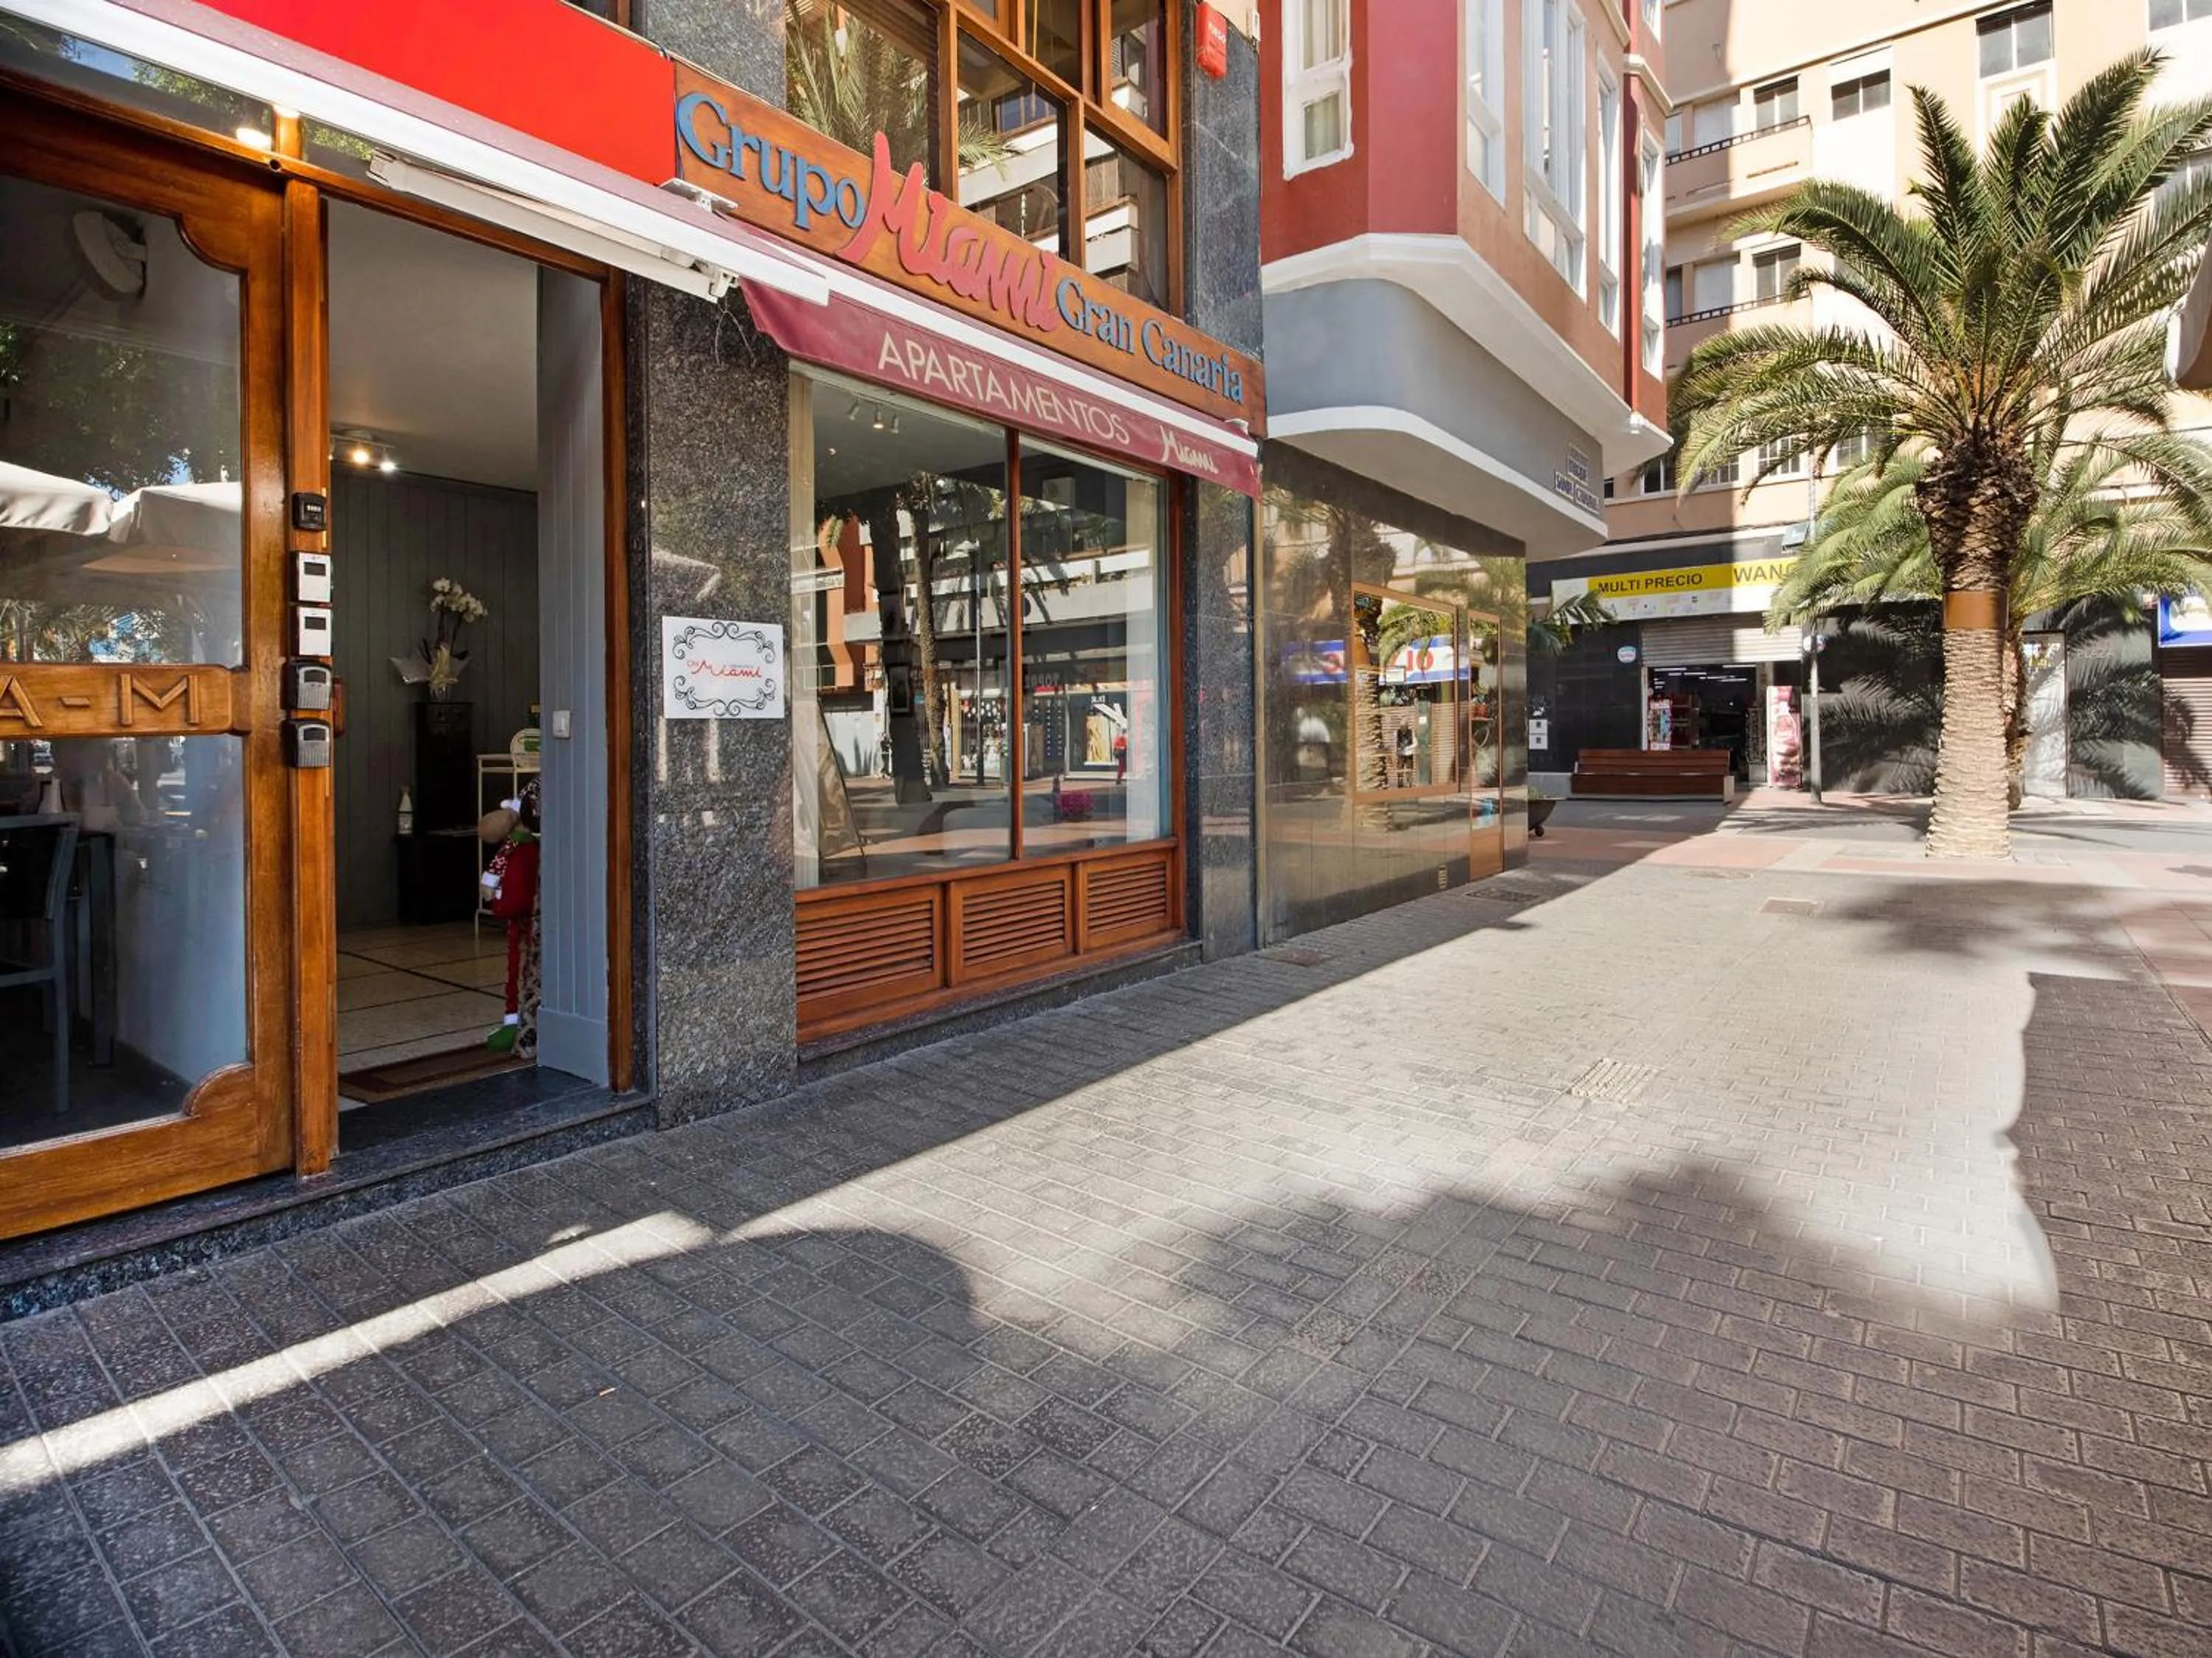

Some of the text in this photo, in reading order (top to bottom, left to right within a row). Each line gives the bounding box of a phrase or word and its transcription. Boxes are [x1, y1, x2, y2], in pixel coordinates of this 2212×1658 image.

[677, 91, 1245, 405] Grupo Miami Gran Canaria
[877, 333, 1220, 476] APARTAMENTOS Miami
[1598, 572, 1703, 594] MULTI PRECIO
